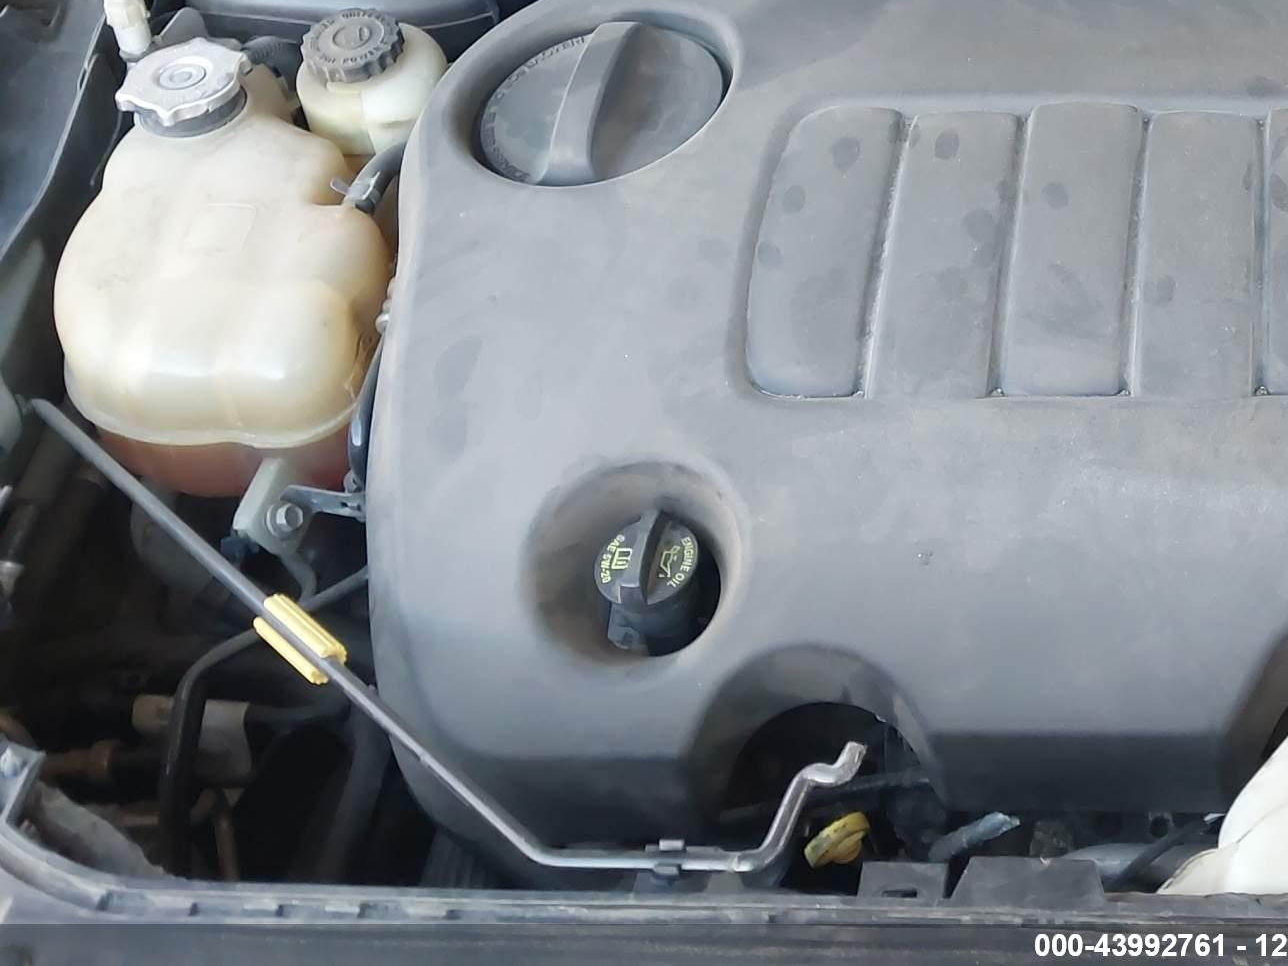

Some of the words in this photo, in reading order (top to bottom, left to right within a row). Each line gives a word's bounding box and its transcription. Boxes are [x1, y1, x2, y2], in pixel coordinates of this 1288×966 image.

[606, 534, 625, 553] SAE
[680, 536, 696, 572] ENGINE
[666, 572, 686, 588] OIL
